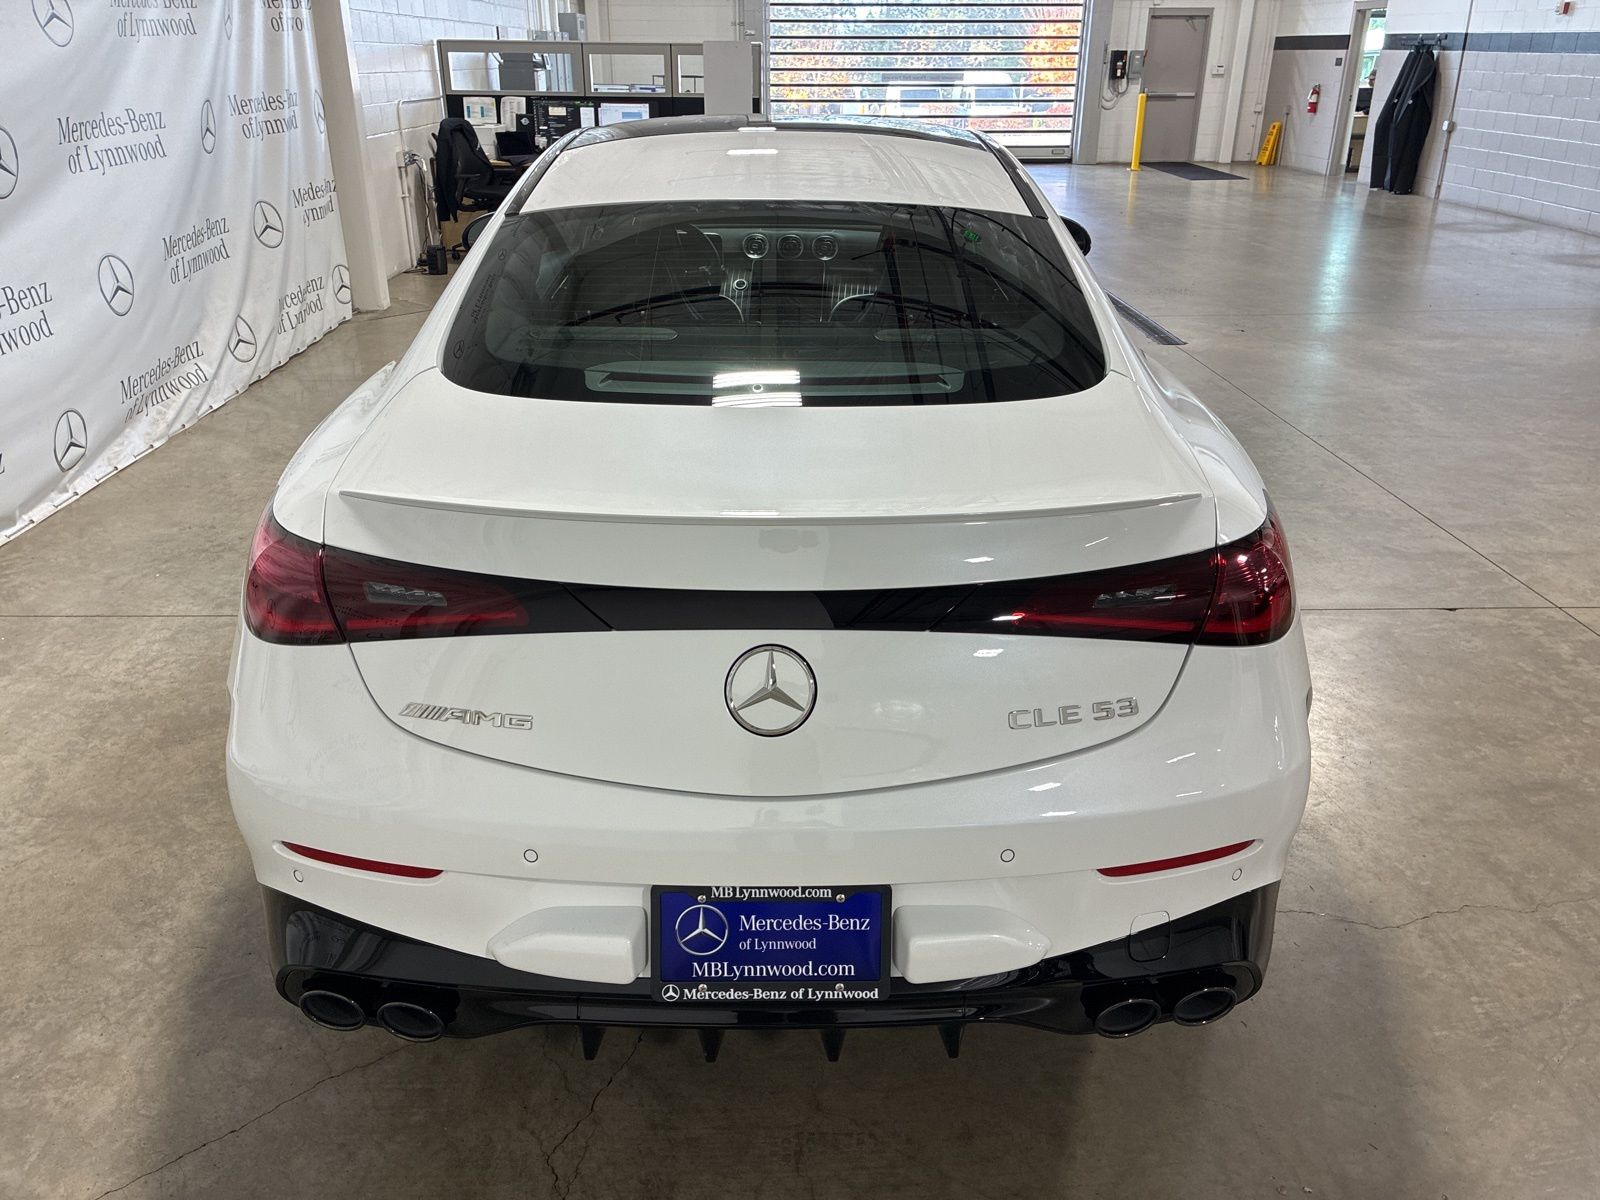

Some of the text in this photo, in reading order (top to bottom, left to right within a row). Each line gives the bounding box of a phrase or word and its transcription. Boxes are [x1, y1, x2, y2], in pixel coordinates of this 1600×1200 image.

[117, 11, 197, 43] of Lynnwood
[270, 11, 285, 32] of
[57, 108, 166, 145] Mercedes-Benz
[242, 117, 255, 139] of
[68, 134, 167, 176] of Lynnwood
[162, 217, 230, 261] Mercedes-Benz
[170, 238, 231, 285] of Lynnwood
[120, 340, 204, 405] Mercedes-Benz
[136, 363, 209, 417] Lynnwood
[1007, 697, 1140, 730] CLE 53
[739, 914, 871, 931] Mercedes-Benz
[738, 937, 817, 953] of Lynnwood
[691, 960, 856, 981] MBLynnwood.com
[682, 987, 880, 1002] Mercedes-Benz of Lynnwood
